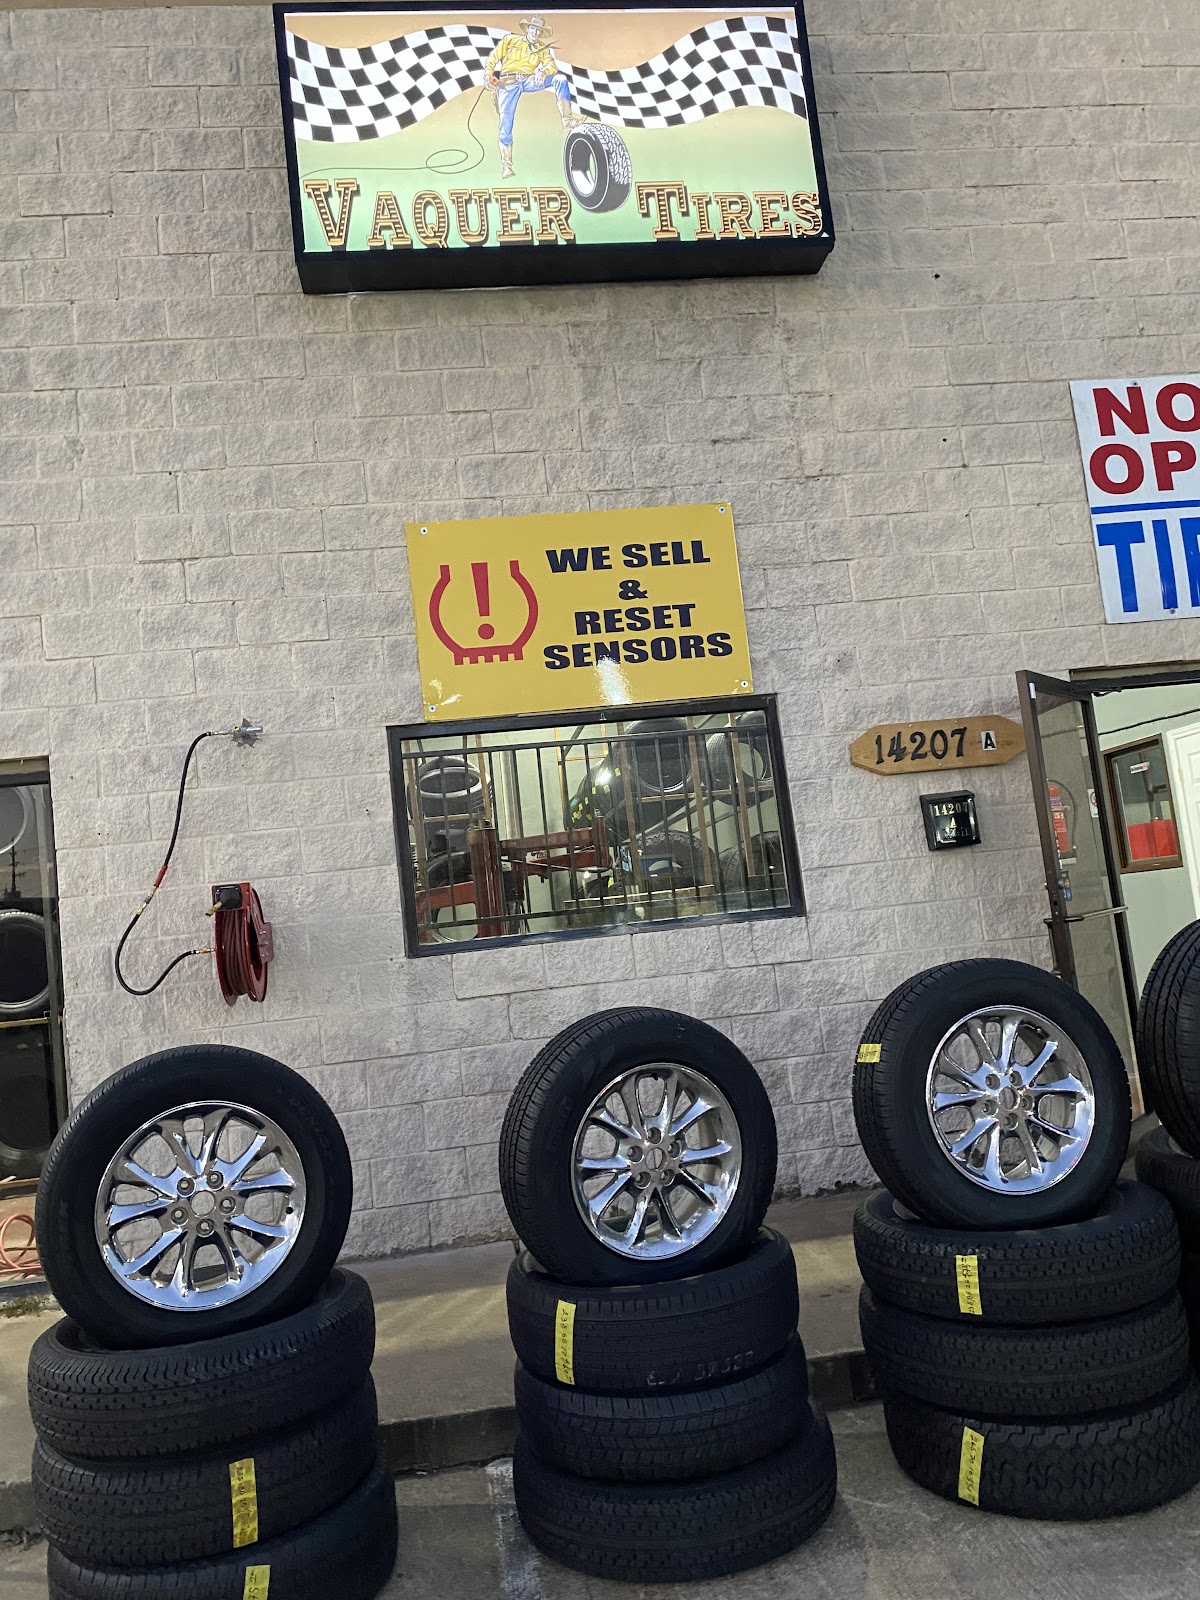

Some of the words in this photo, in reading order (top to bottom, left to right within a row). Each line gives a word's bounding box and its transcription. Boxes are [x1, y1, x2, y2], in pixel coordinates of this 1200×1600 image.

[635, 180, 825, 241] TIRES
[1092, 382, 1200, 437] NO
[1089, 440, 1197, 495] OP
[546, 546, 613, 574] WE
[621, 540, 711, 569] SELL
[618, 579, 649, 601] &
[574, 603, 696, 636] RESET
[543, 632, 733, 670] SENSORS
[874, 727, 967, 765] 14207
[983, 732, 997, 750] A
